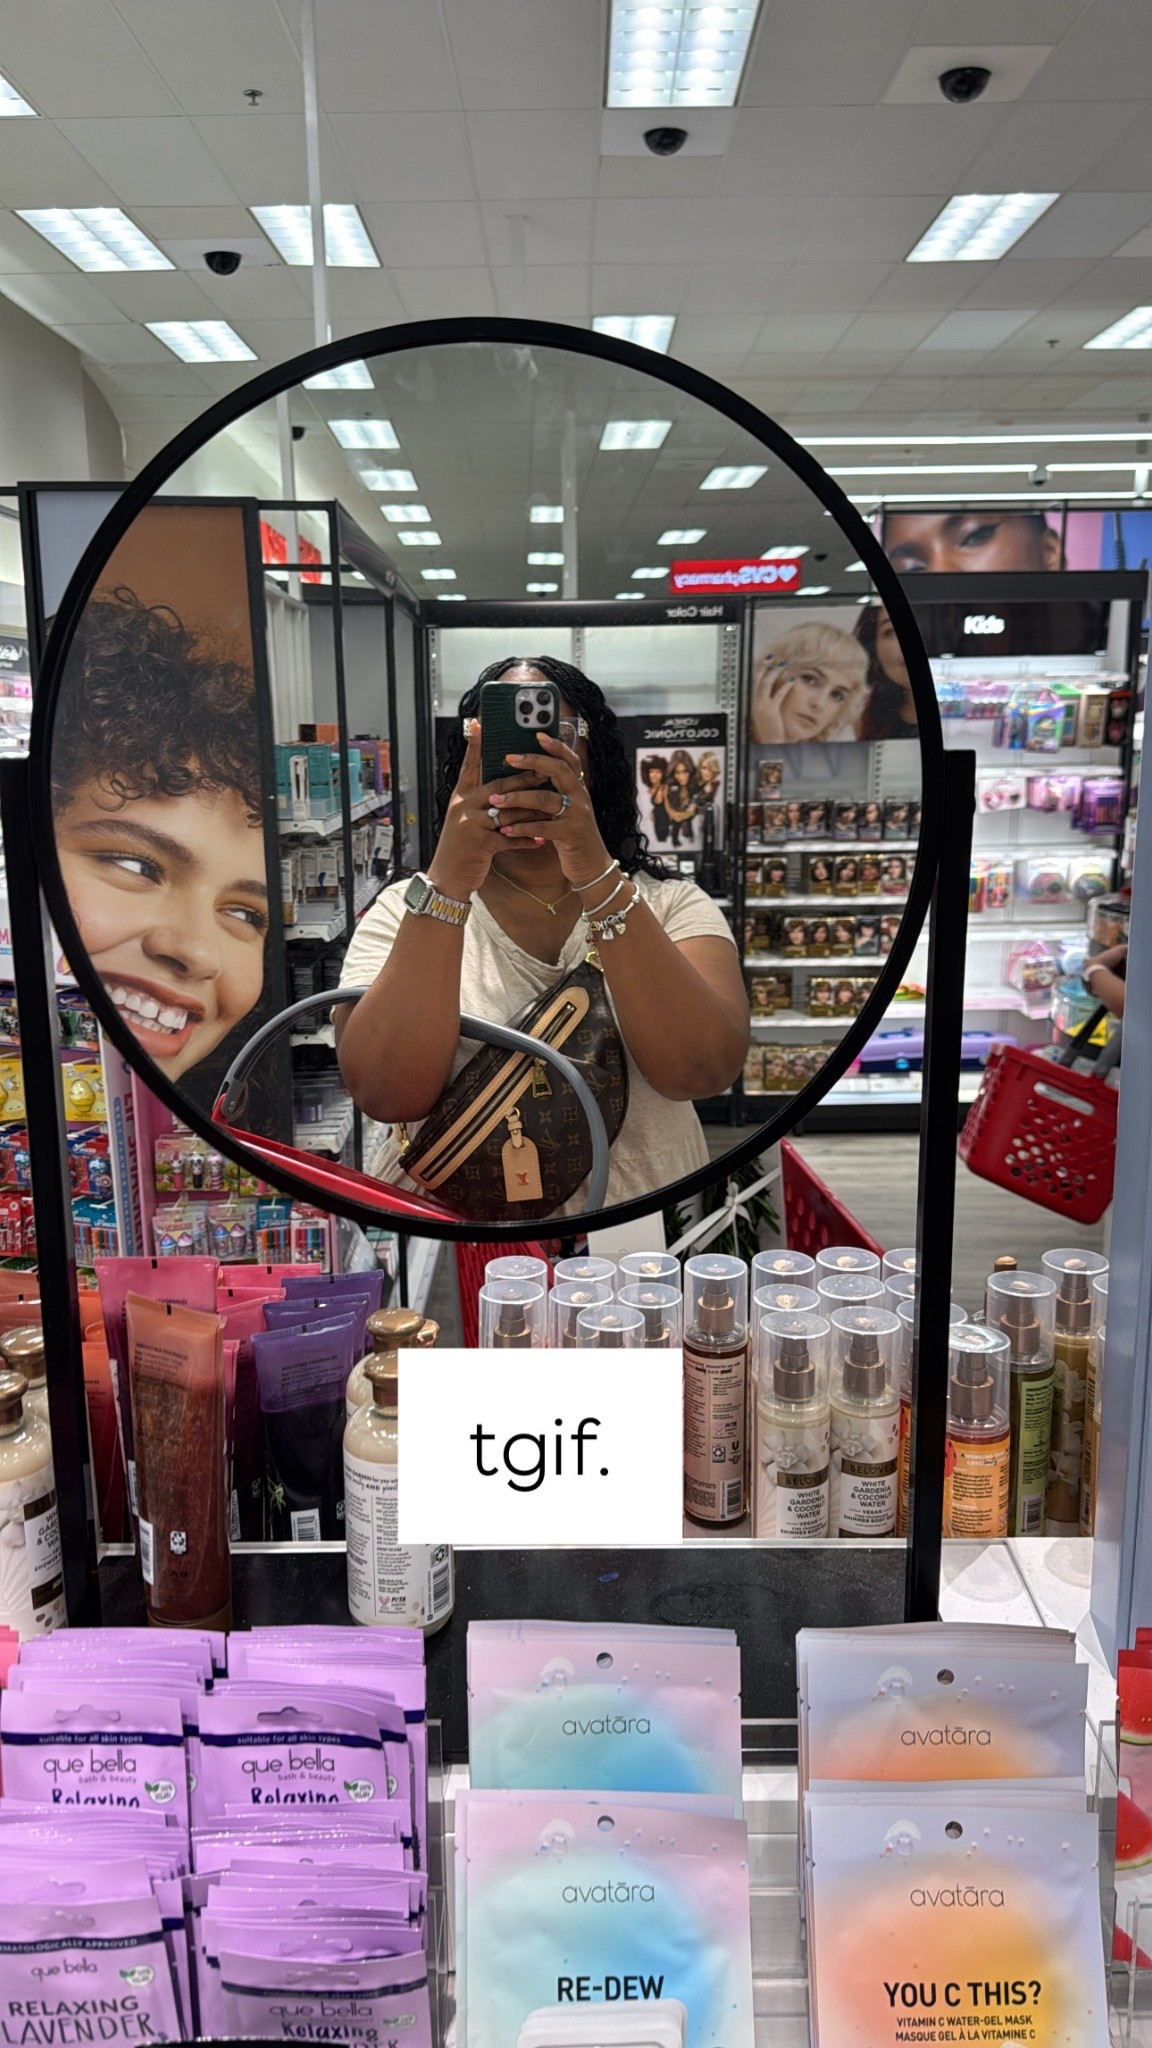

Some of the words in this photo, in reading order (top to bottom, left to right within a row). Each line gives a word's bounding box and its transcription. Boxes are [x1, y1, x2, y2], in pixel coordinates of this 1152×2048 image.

[963, 614, 1006, 635] Kids
[853, 1485, 892, 1494] GARDENIA
[861, 1479, 886, 1487] WHITE
[789, 1494, 825, 1506] GARDENIA
[797, 1488, 821, 1498] WHITE
[857, 1491, 892, 1501] COCONUT
[793, 1500, 826, 1513] COCONUT
[860, 1500, 886, 1508] WATER
[795, 1509, 821, 1519] WATER
[562, 1714, 651, 1736] avatāra
[39, 1733, 72, 1744] suitable
[74, 1733, 87, 1743] for
[89, 1732, 99, 1743] all
[101, 1732, 118, 1743] skin
[119, 1734, 143, 1745] types
[237, 1734, 270, 1744] suitable
[272, 1733, 285, 1743] for
[287, 1732, 298, 1743] all
[300, 1731, 317, 1742] skin
[318, 1733, 341, 1744] types
[900, 1724, 992, 1746] avatāra
[43, 1757, 84, 1784] que
[90, 1748, 137, 1773] bella
[241, 1757, 283, 1783] que
[289, 1747, 335, 1773] bella
[78, 1773, 98, 1784] bath
[109, 1774, 137, 1786] beauty
[278, 1772, 297, 1782] bath
[308, 1772, 336, 1783] beauty
[562, 1879, 655, 1903] avatāra
[910, 1883, 1005, 1907] avatāra
[85, 1938, 138, 1949] APPROVED
[30, 1964, 61, 1982] que
[63, 1957, 98, 1975] bella
[557, 1974, 665, 2003] RE-DEW
[883, 1981, 937, 2008] YOU
[944, 1982, 961, 2007] C
[966, 1980, 1042, 2007] THIS?
[8, 1995, 139, 2017] RELAXING
[269, 2003, 314, 2020] que
[321, 2001, 373, 2018] bella
[896, 2017, 937, 2028] VITAMIN
[938, 2016, 945, 2027] C
[946, 2015, 1003, 2027] WATER-GEL
[1004, 2014, 1033, 2025] MASK
[1, 2012, 155, 2046] LAVENDER
[895, 2031, 937, 2042] MASQUE
[938, 2030, 957, 2042] GEL
[959, 2028, 966, 2041] À
[967, 2030, 981, 2041] LA
[981, 2029, 1028, 2041] VITAMINE
[1029, 2029, 1036, 2040] C
